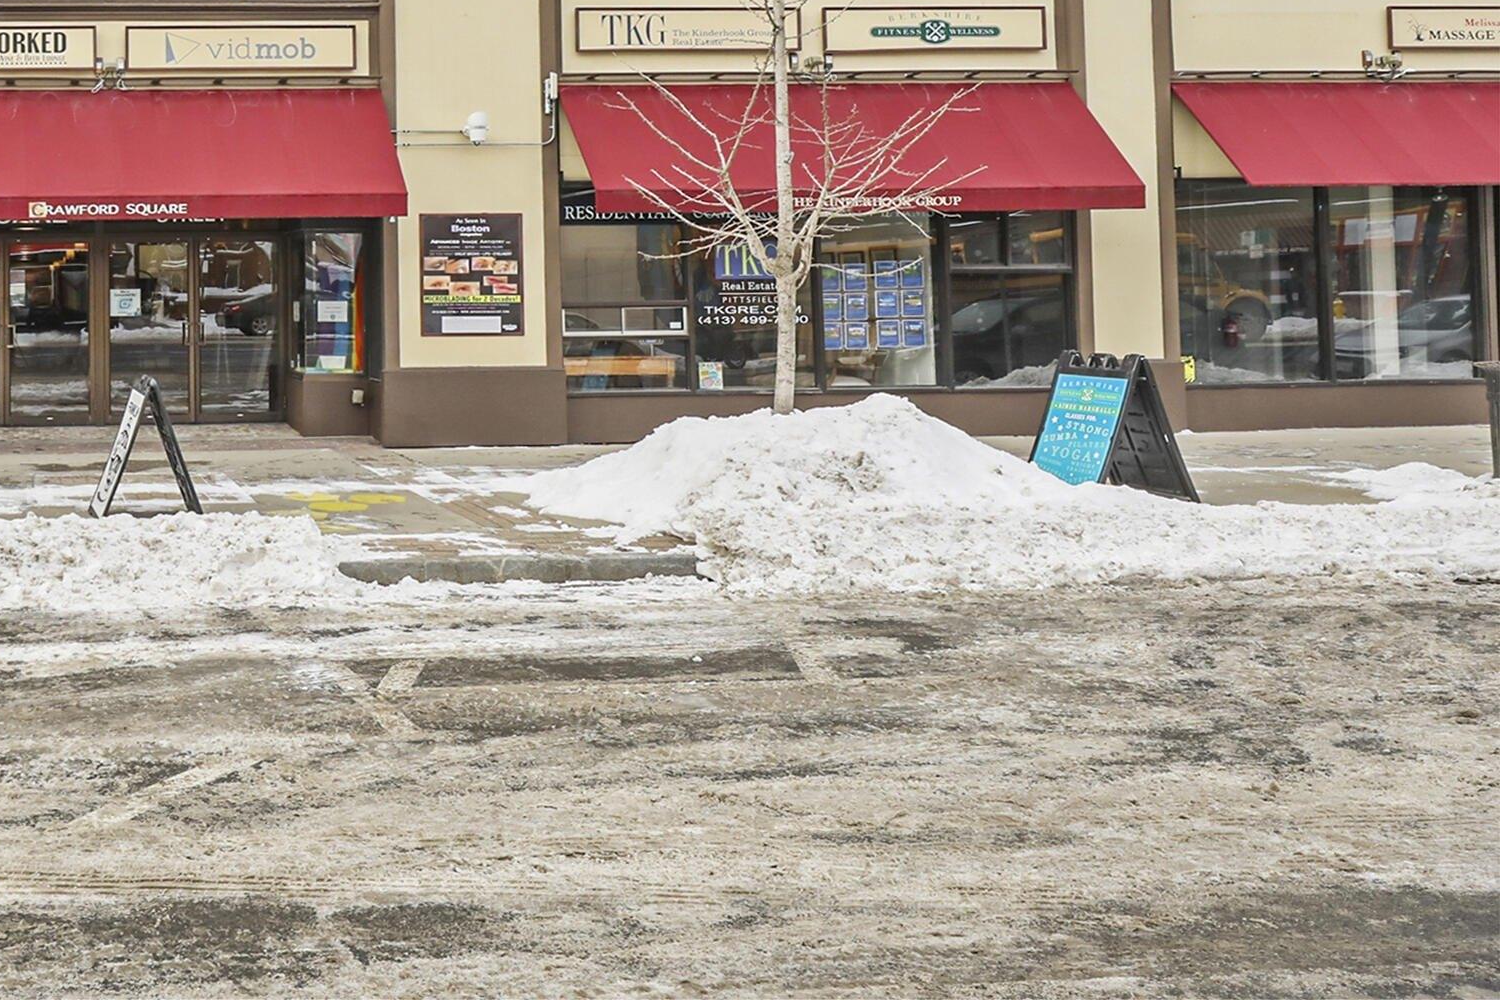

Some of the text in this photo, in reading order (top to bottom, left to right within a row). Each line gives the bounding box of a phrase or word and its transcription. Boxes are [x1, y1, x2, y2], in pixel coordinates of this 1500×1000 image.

[602, 14, 666, 46] TKG
[672, 29, 690, 37] The
[692, 28, 745, 37] Kinderhook
[877, 27, 995, 36] FITNESS WELLNESS
[1429, 30, 1496, 40] MASSAGE
[206, 37, 316, 59] vidmob
[916, 196, 962, 206] GROUP
[31, 203, 188, 216] CRAWFORD SQUARE
[722, 282, 745, 290] Real
[698, 316, 736, 325] (413)
[1065, 421, 1109, 437] STRONG
[1051, 446, 1091, 462] YOGA
